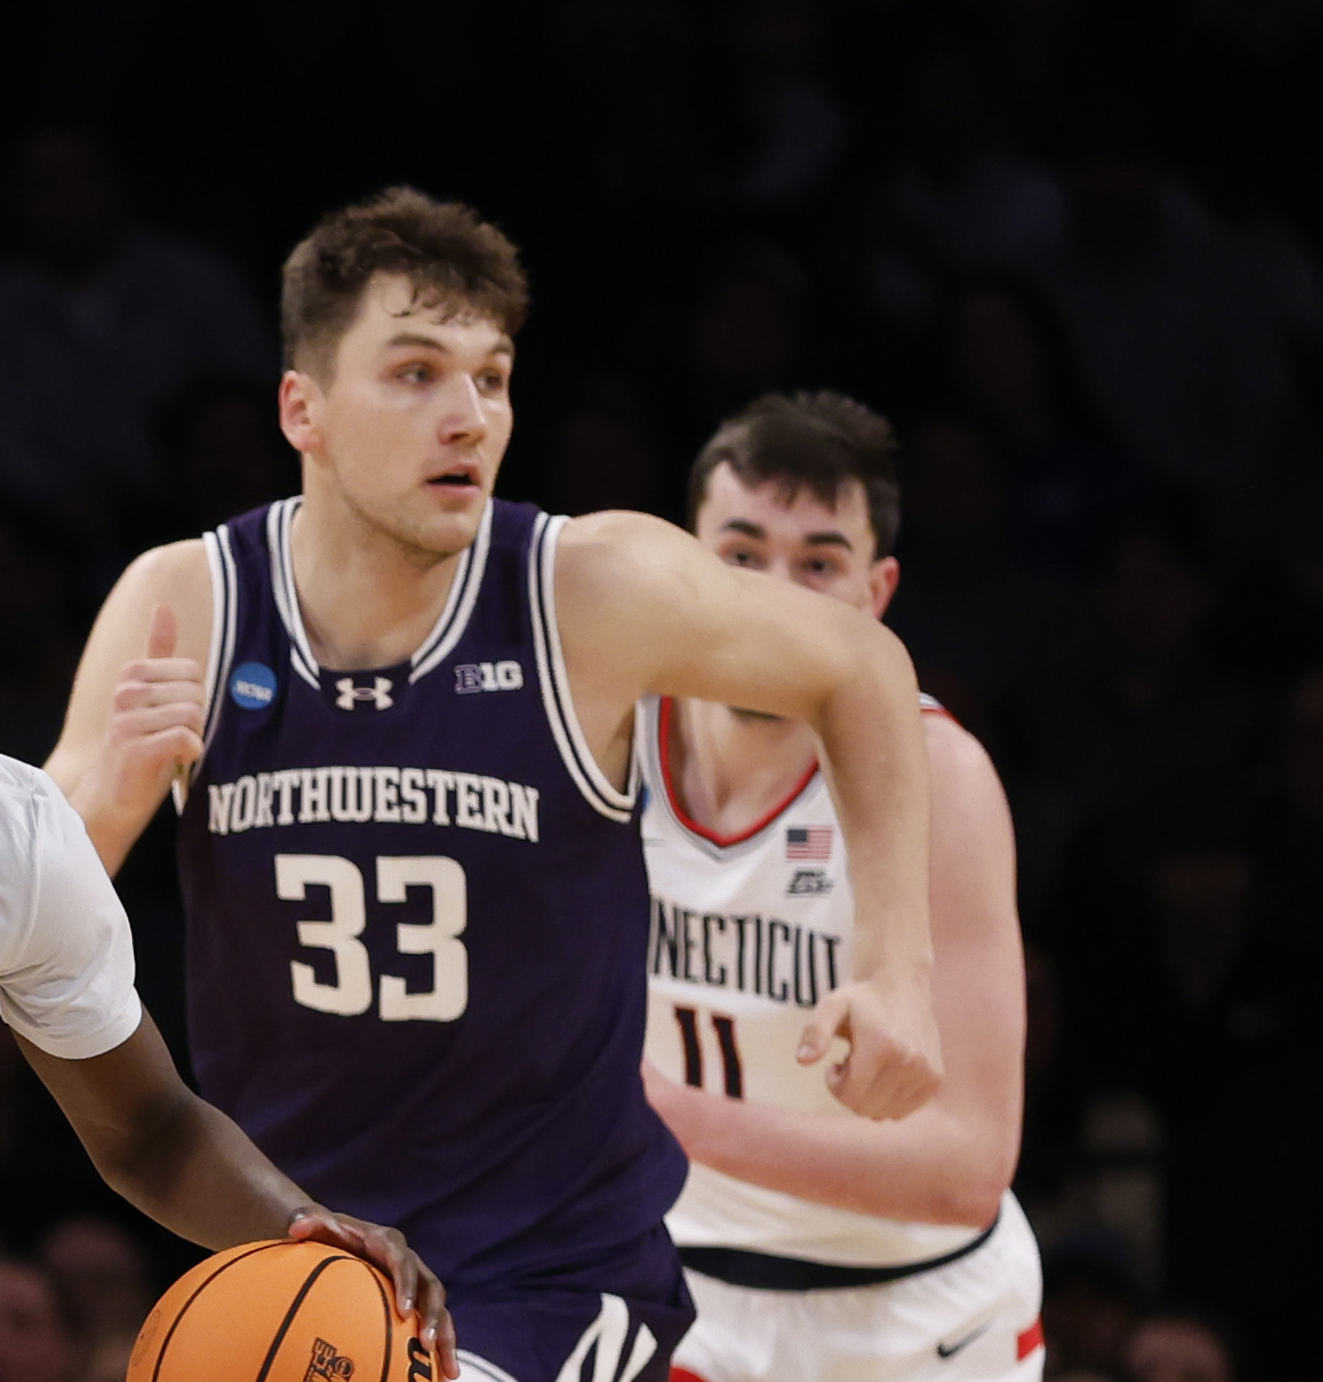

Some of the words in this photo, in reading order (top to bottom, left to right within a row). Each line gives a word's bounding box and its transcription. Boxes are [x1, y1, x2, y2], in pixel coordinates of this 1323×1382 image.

[208, 766, 539, 843] NORTHWESTERN
[274, 854, 469, 1022] 33
[649, 898, 839, 1009] NECTICUT
[675, 1006, 743, 1100] 11
